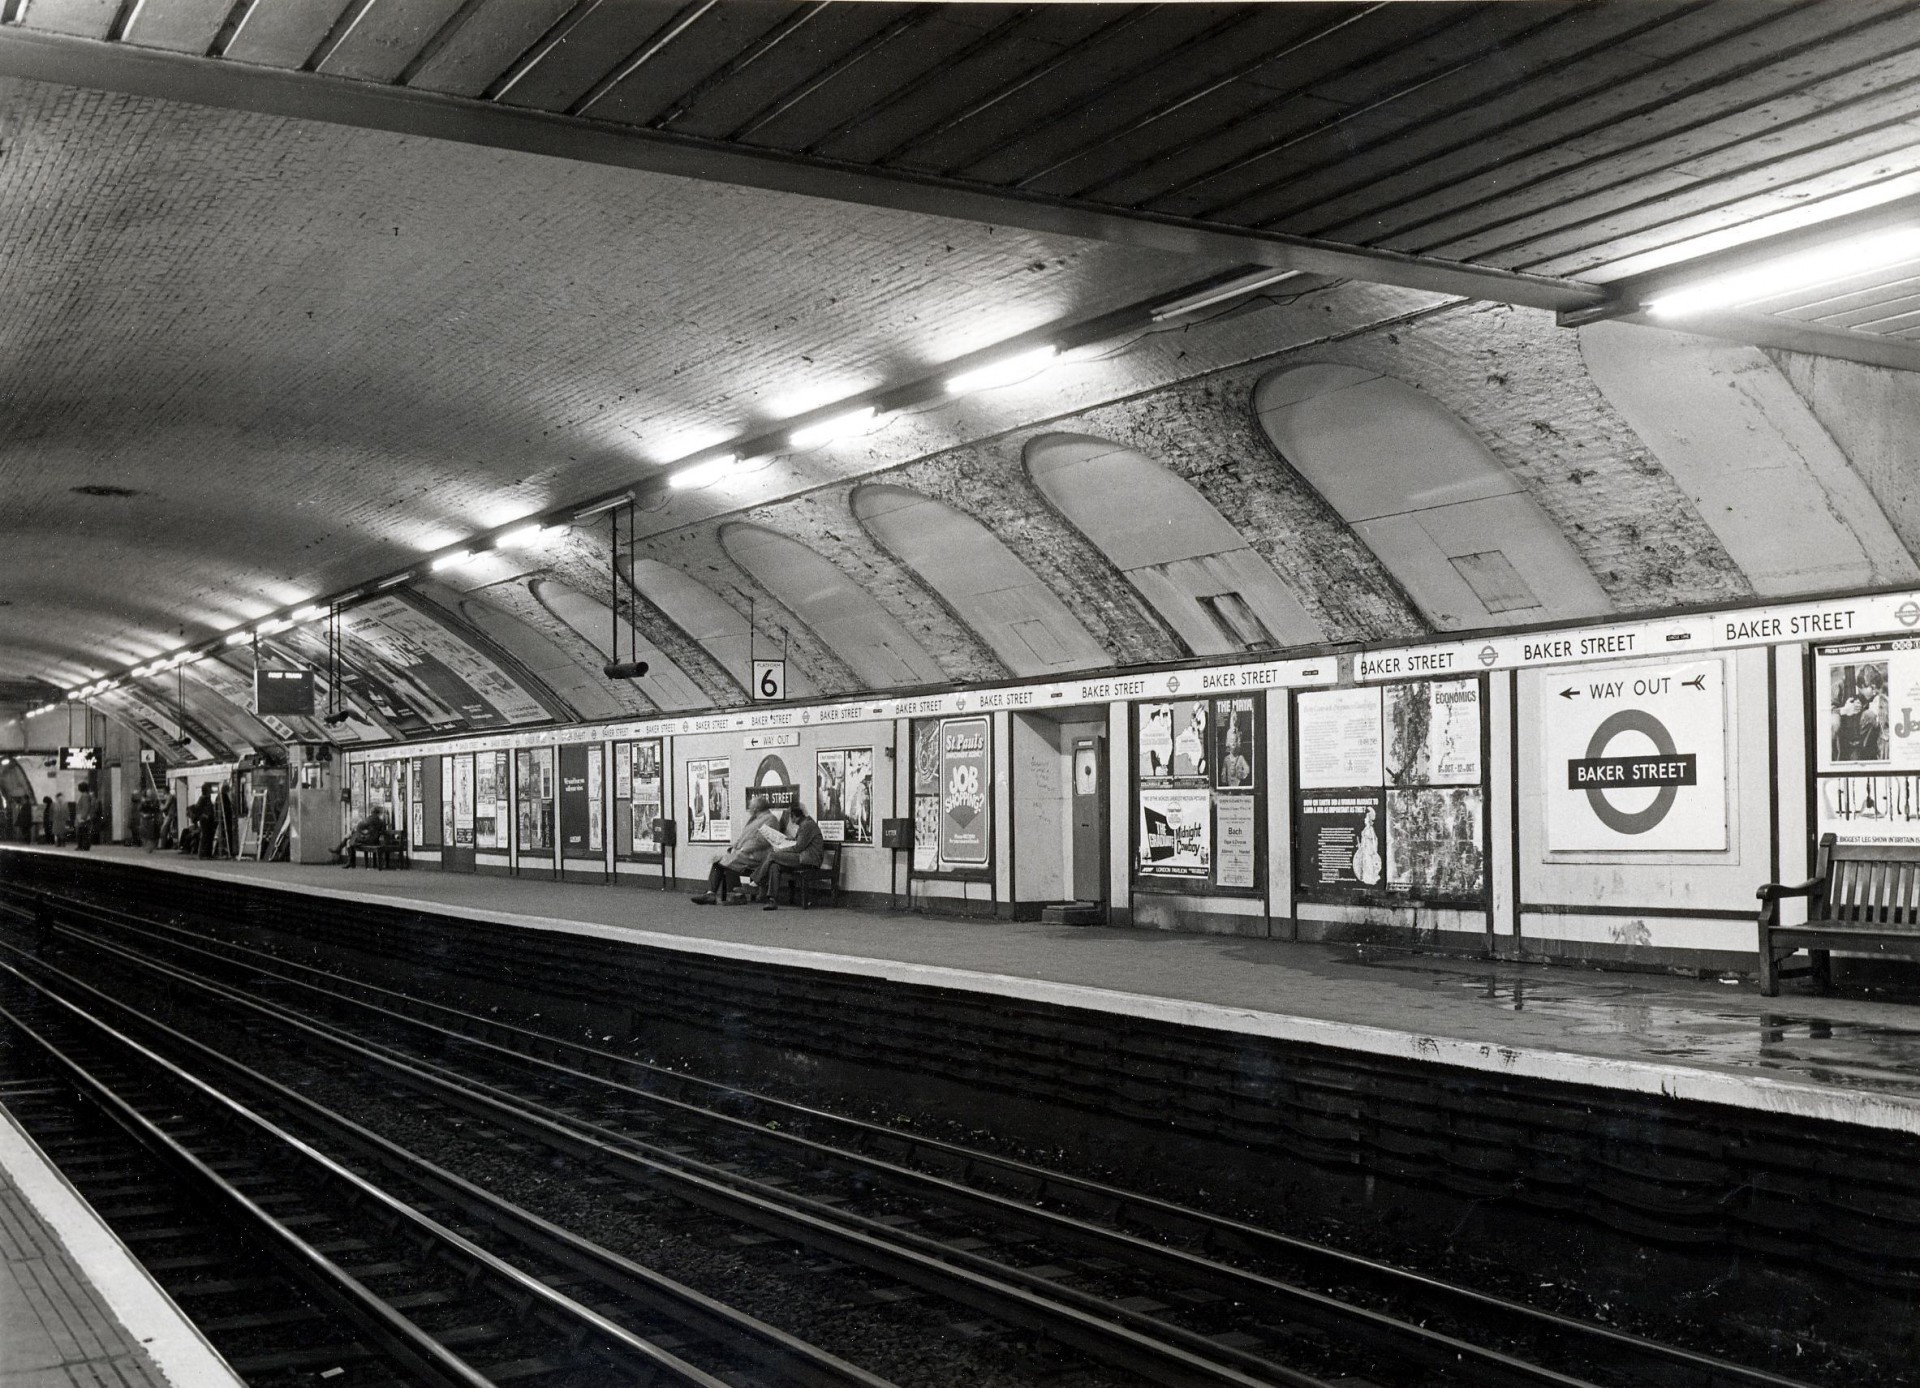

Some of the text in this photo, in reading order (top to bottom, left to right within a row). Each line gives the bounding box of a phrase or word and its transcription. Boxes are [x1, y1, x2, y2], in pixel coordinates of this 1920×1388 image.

[1726, 611, 1855, 641] BAKER STREET
[1524, 634, 1636, 660] BAKER STREET
[1360, 652, 1454, 676] BAKER STREET
[761, 669, 777, 697] 6
[1203, 669, 1278, 689] BAKER STREET
[1589, 677, 1671, 699] WAY OUT
[1082, 681, 1145, 699] BAKER STREET
[1435, 690, 1477, 705] ECONOMICS
[896, 700, 942, 715] BAKER STREET
[980, 692, 1033, 707] BAKER STREET
[1216, 699, 1254, 713] THE MAYA
[751, 713, 792, 726] BAKER STREET
[819, 707, 862, 721] BAKER STREET
[646, 723, 676, 734] BAKER STREET
[695, 719, 729, 731] BAKER STREET
[764, 734, 789, 746] WAY OUT
[949, 765, 979, 794] JOB
[1577, 762, 1687, 782] BAKER STREET
[772, 792, 794, 803] STREET
[945, 791, 985, 814] SHOPPING?
[1176, 822, 1202, 841] Midnight
[1228, 827, 1243, 835] Bach
[1177, 839, 1201, 857] Cowboy
